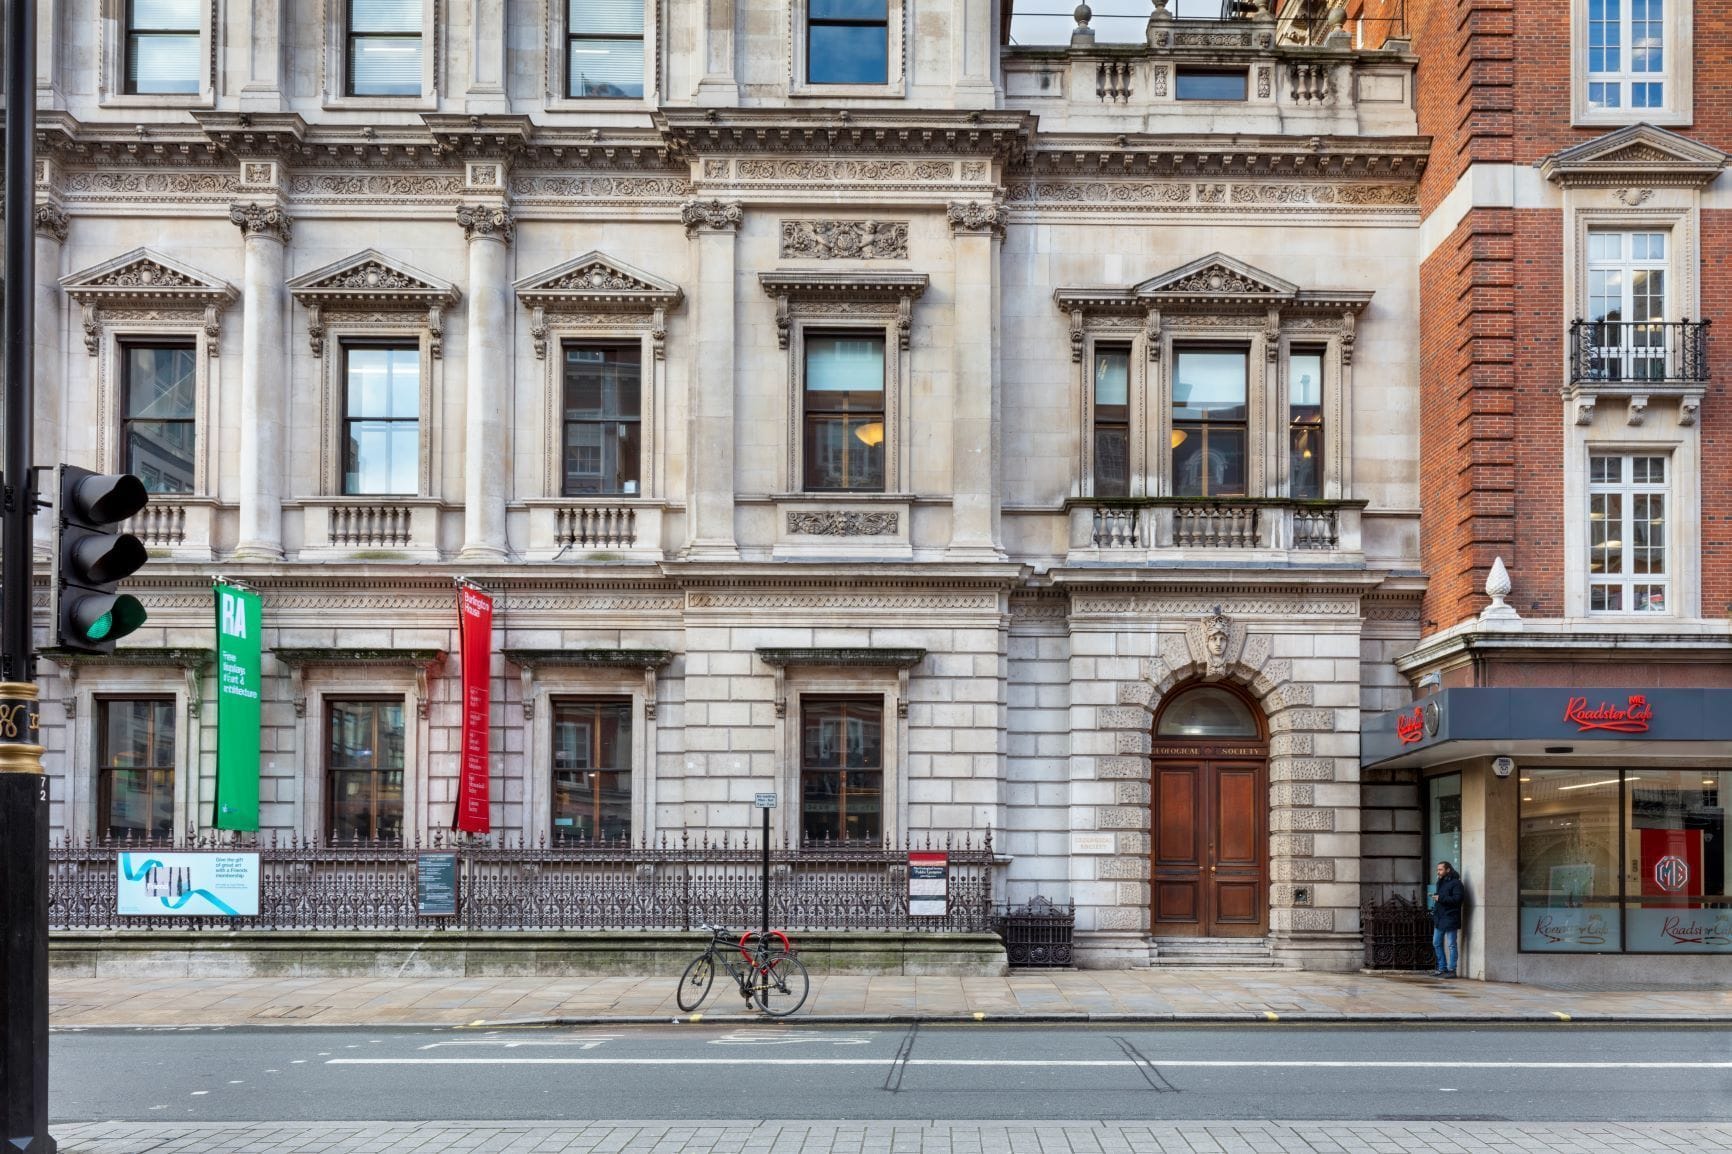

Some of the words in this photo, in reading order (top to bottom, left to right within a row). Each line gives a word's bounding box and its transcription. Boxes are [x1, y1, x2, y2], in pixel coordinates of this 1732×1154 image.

[464, 591, 490, 612] Burlington
[464, 602, 481, 618] House
[222, 592, 247, 640] RA
[1563, 696, 1627, 724] Roadster
[1221, 747, 1260, 755] SOCIETY
[1659, 859, 1685, 887] MG
